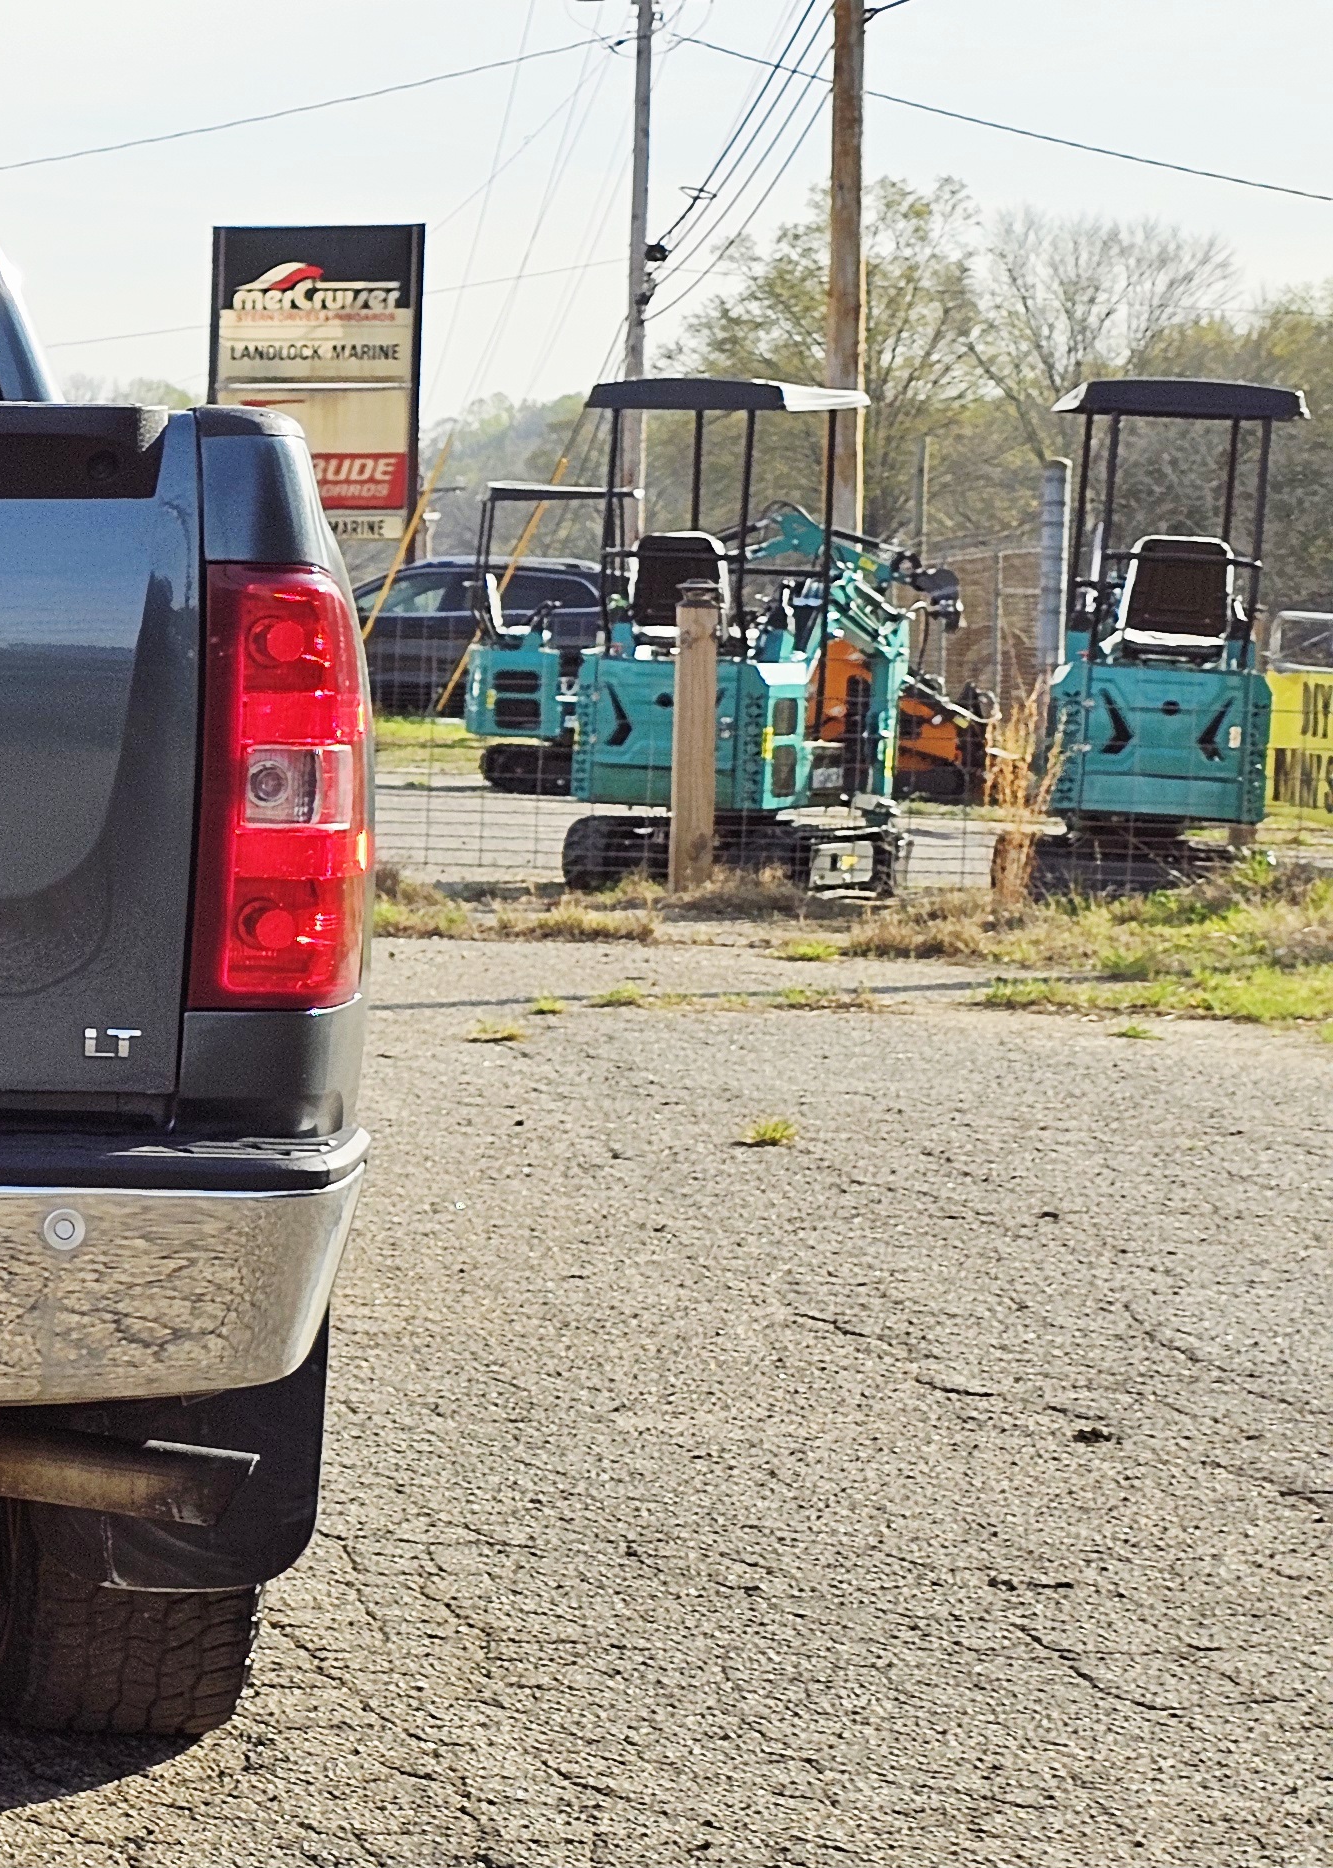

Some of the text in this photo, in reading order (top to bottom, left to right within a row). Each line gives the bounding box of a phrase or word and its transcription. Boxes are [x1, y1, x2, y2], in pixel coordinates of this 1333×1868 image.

[230, 343, 401, 361] LANDLOCK MARINE
[312, 458, 399, 481] RUDE
[84, 1027, 143, 1058] LT
